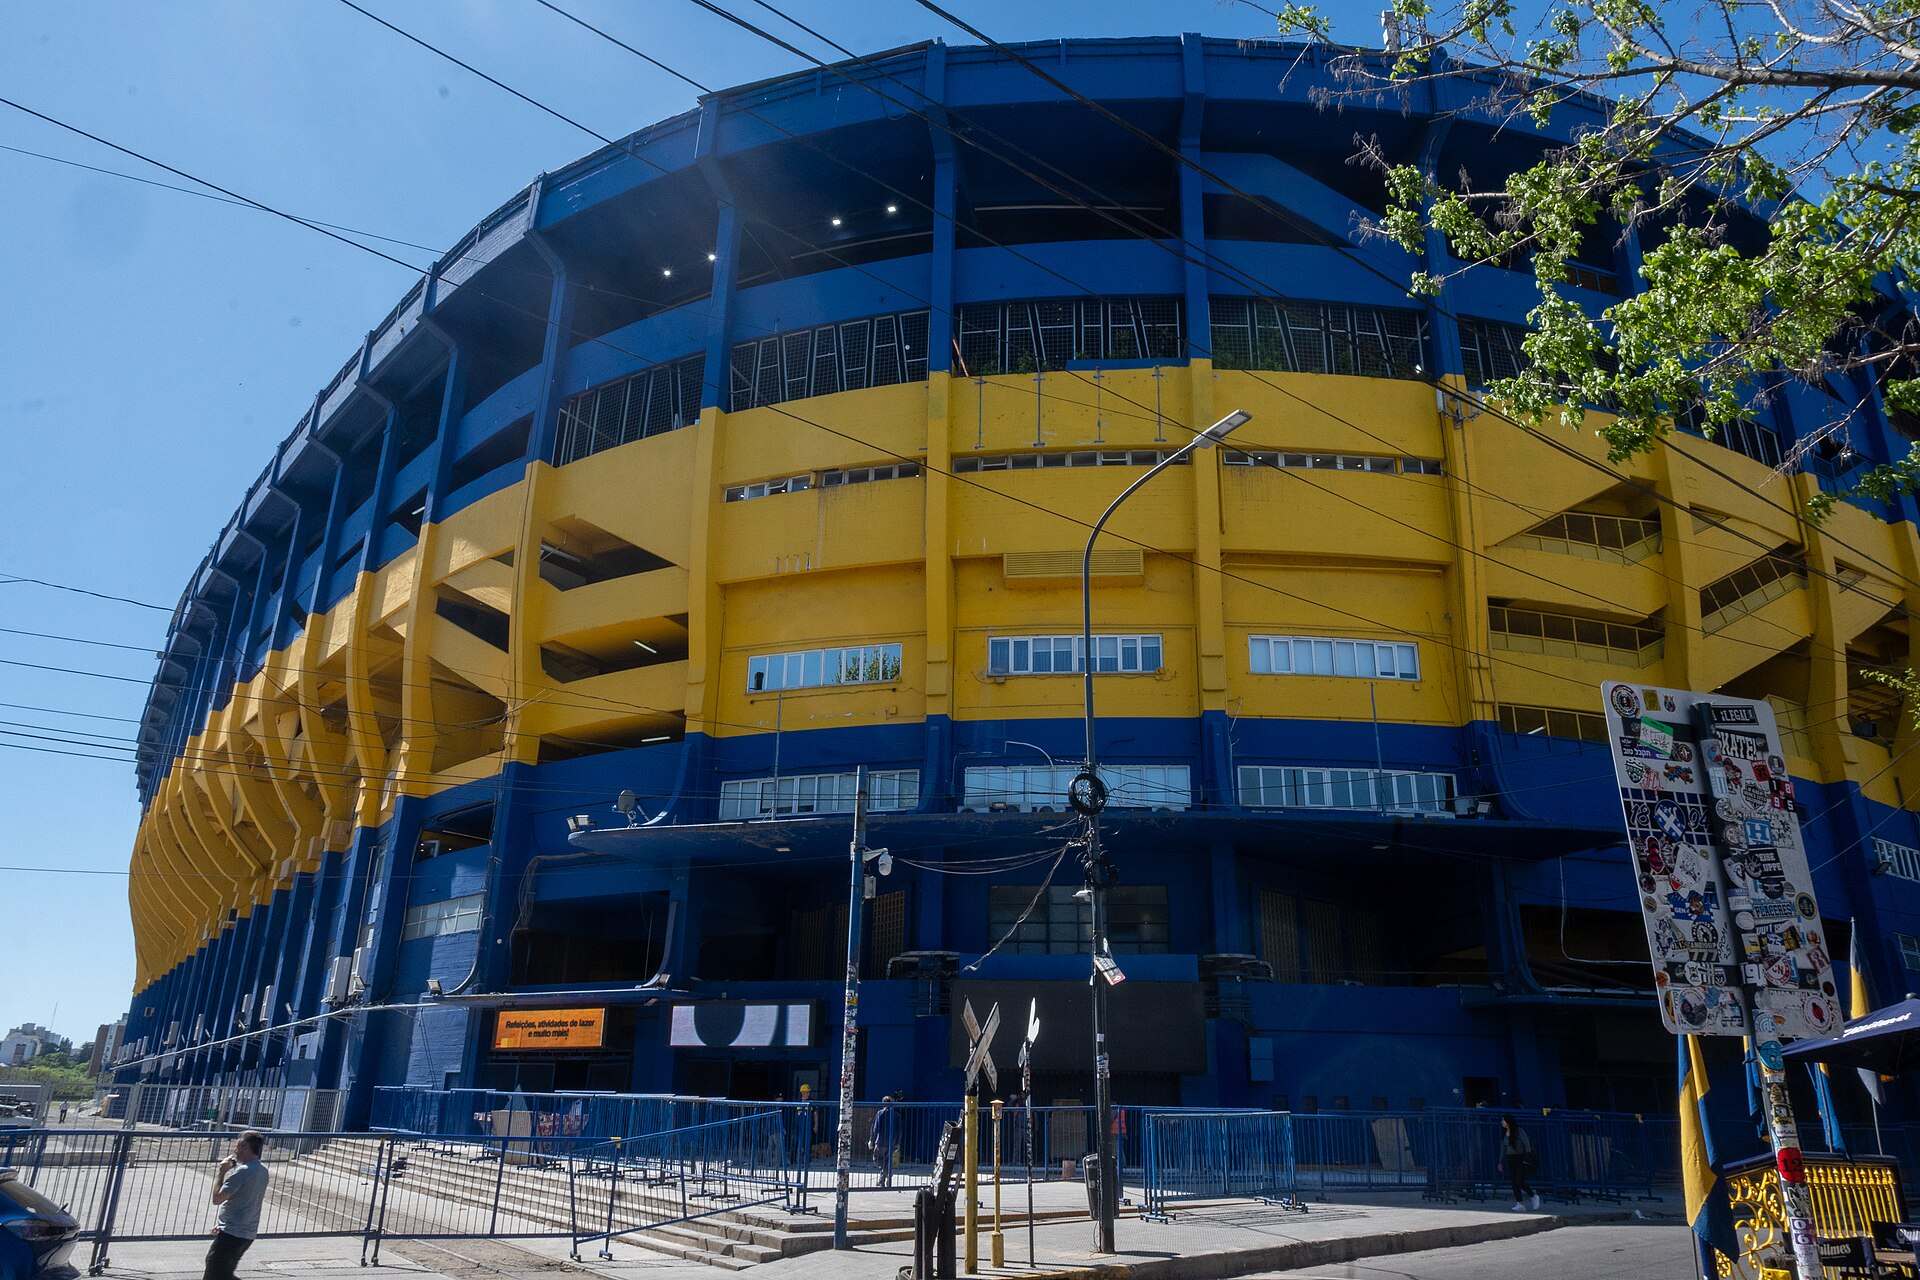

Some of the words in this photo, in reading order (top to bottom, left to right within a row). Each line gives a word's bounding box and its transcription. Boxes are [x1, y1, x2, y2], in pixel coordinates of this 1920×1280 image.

[1755, 904, 1792, 917] PLACERES
[506, 1021, 536, 1030] Refeições,
[538, 1020, 568, 1028] atividades
[570, 1019, 578, 1027] de
[579, 1019, 595, 1027] lazer
[552, 1029, 569, 1037] mais!
[1817, 1243, 1851, 1256] uilmes
